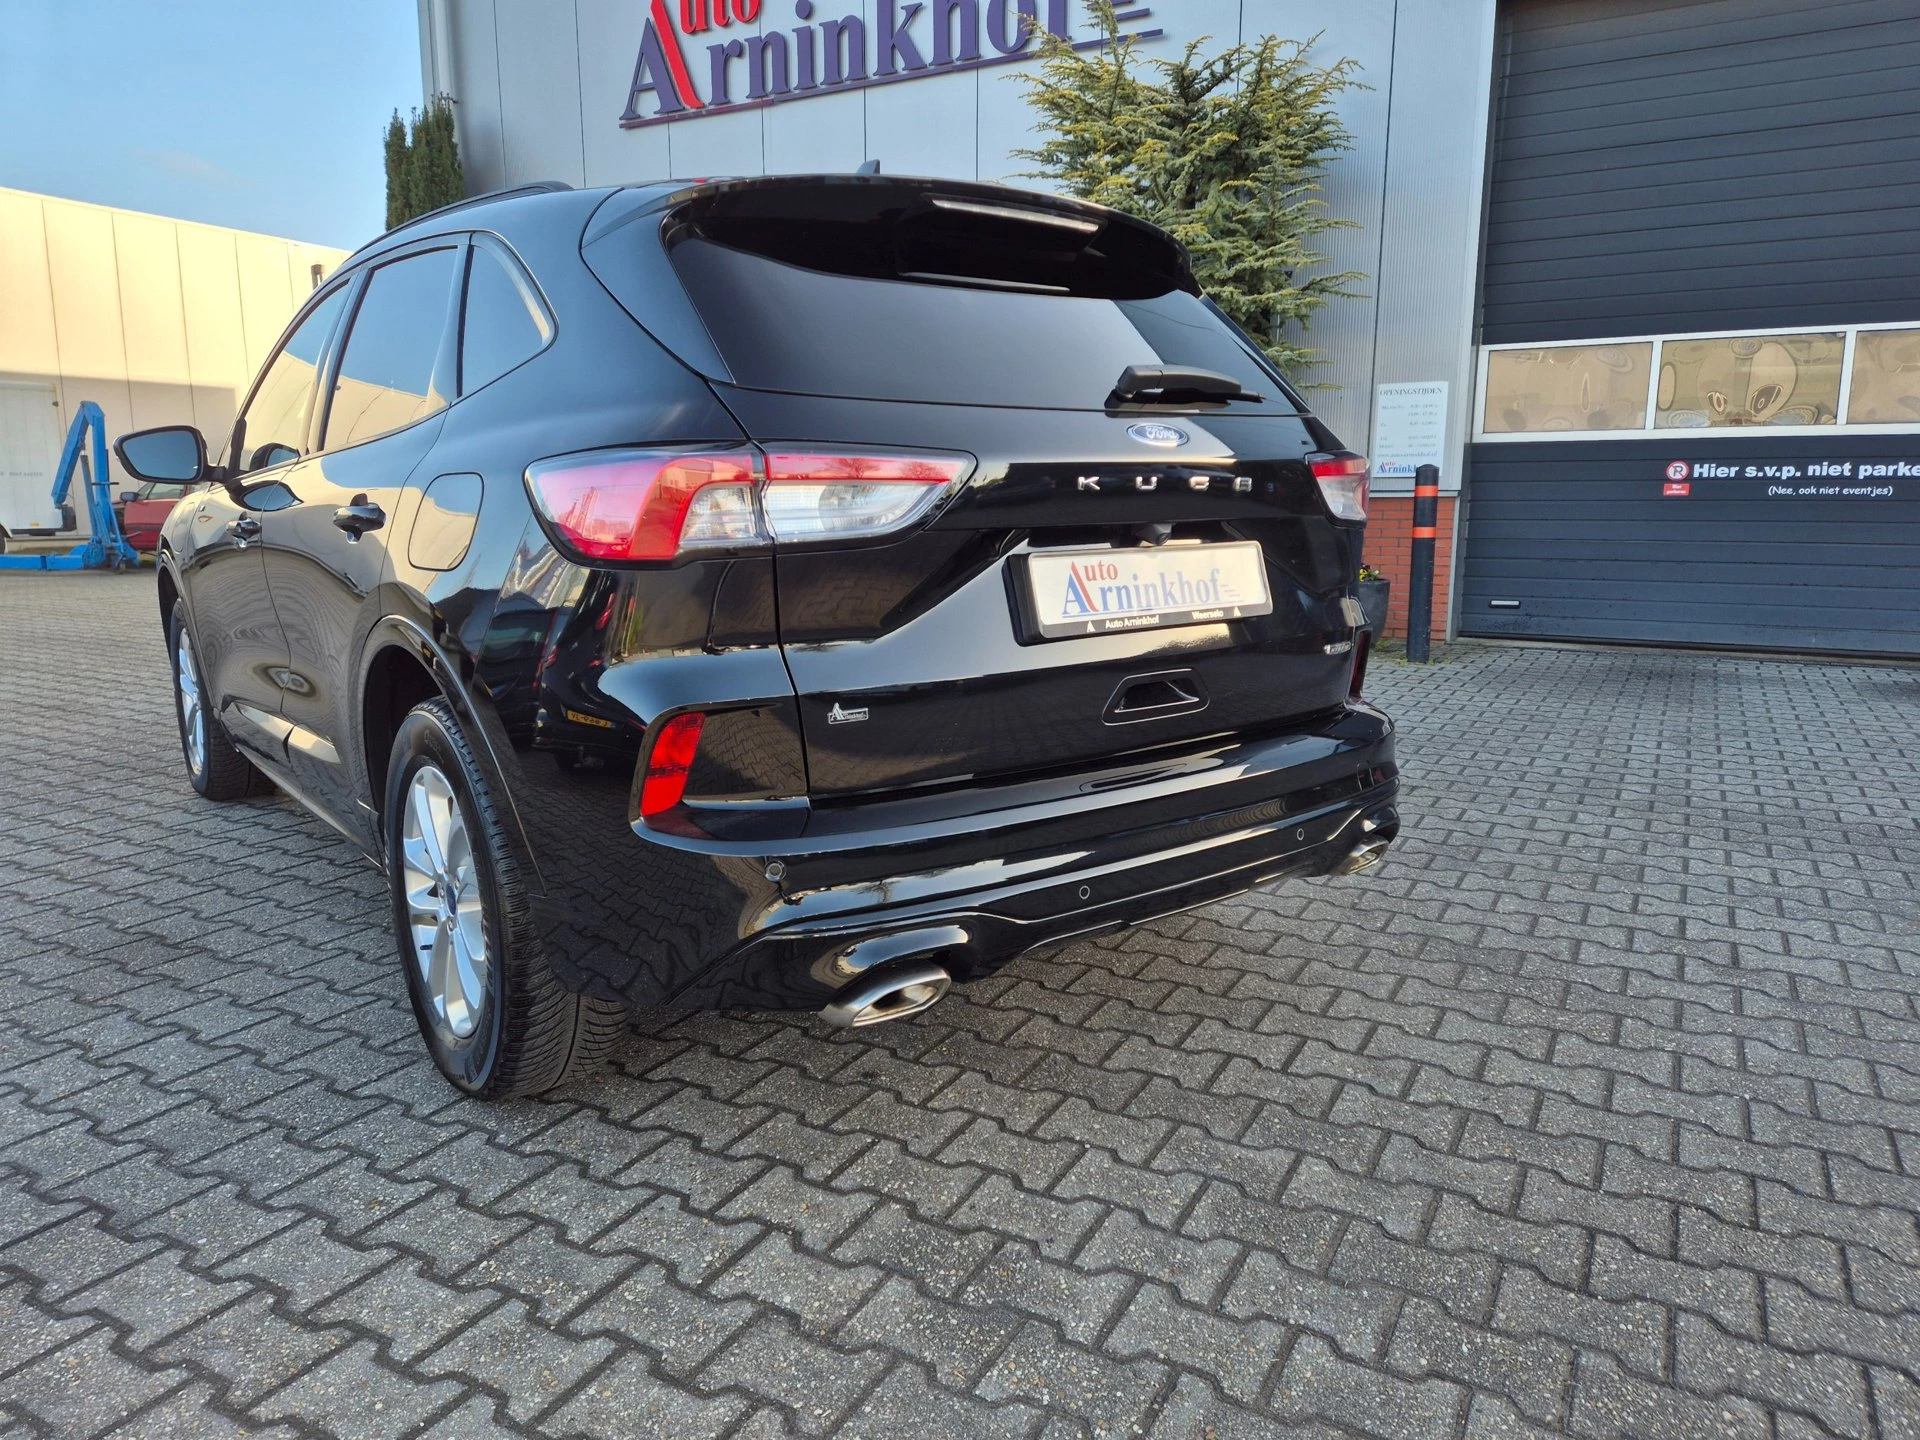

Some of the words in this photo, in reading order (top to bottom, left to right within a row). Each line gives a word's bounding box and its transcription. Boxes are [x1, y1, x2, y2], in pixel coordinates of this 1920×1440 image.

[1145, 426, 1180, 440] Ford
[1693, 463, 1739, 478] Hier
[1744, 464, 1801, 480] s.v.p.
[1807, 462, 1852, 477] niet
[1768, 486, 1796, 496] (Nee,
[1798, 485, 1817, 496] ook
[1819, 486, 1839, 496] niet
[1842, 485, 1893, 497] eventjes)
[1062, 568, 1221, 615] Arninkhof
[1105, 619, 1124, 629] Auto
[1124, 615, 1160, 628] Arninkhof
